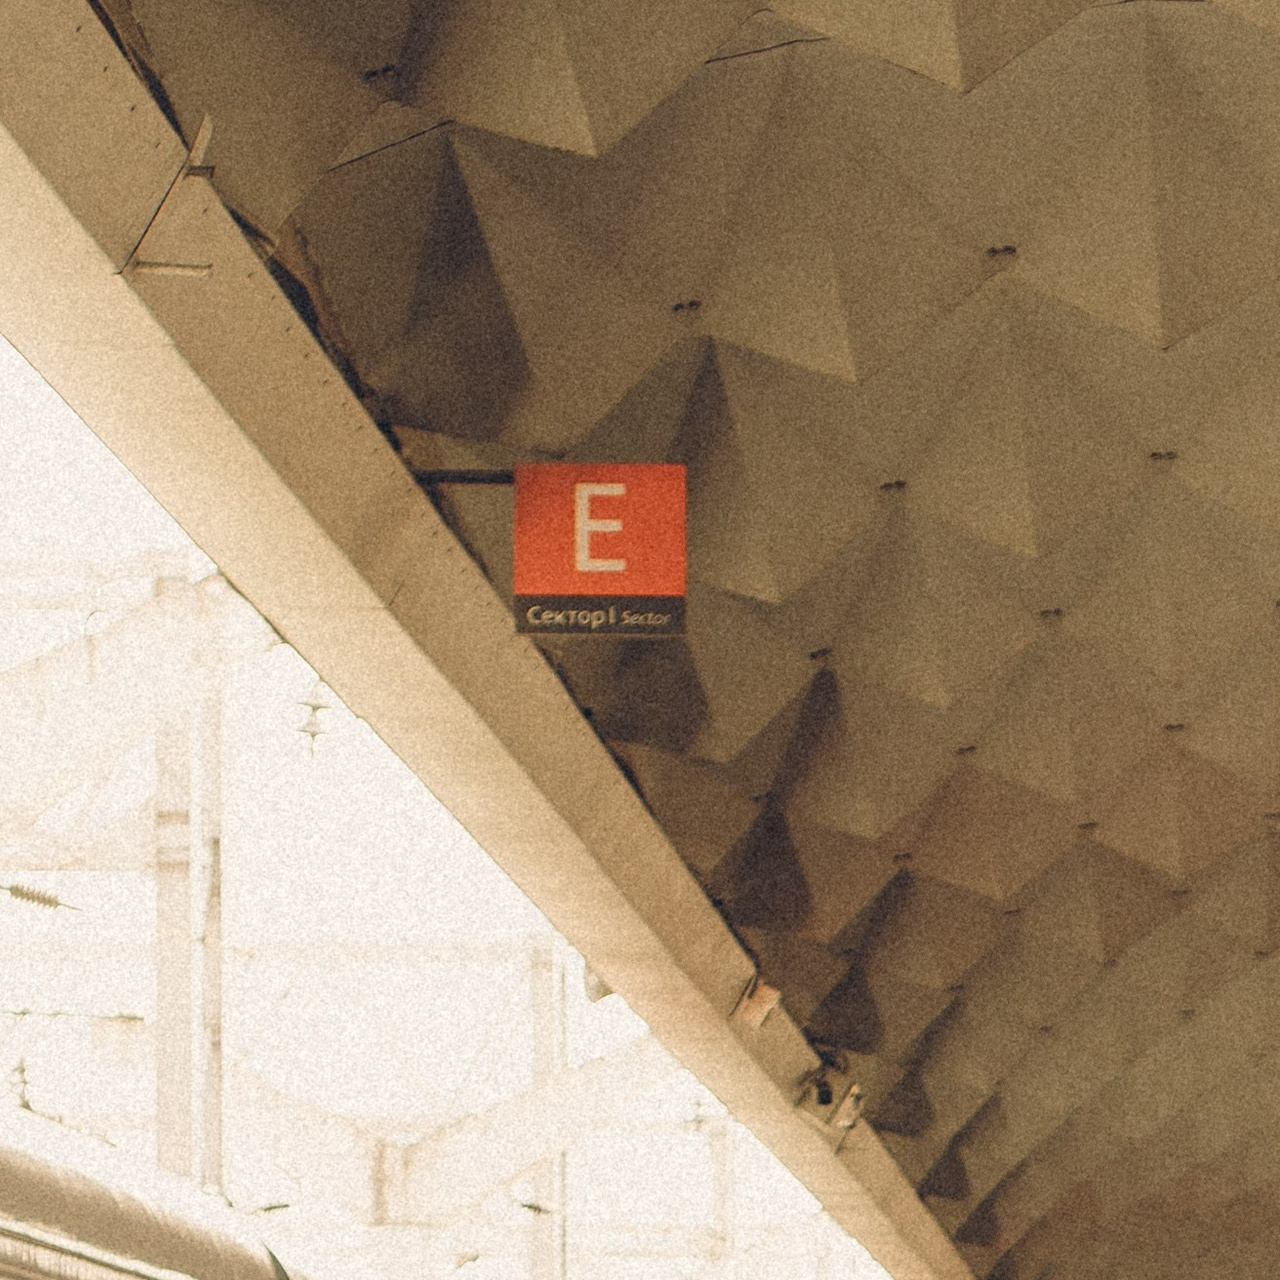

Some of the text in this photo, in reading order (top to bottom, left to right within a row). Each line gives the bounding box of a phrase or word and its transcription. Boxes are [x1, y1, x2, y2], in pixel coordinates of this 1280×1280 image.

[575, 482, 627, 572] E
[526, 605, 672, 629] Сектор Sector
